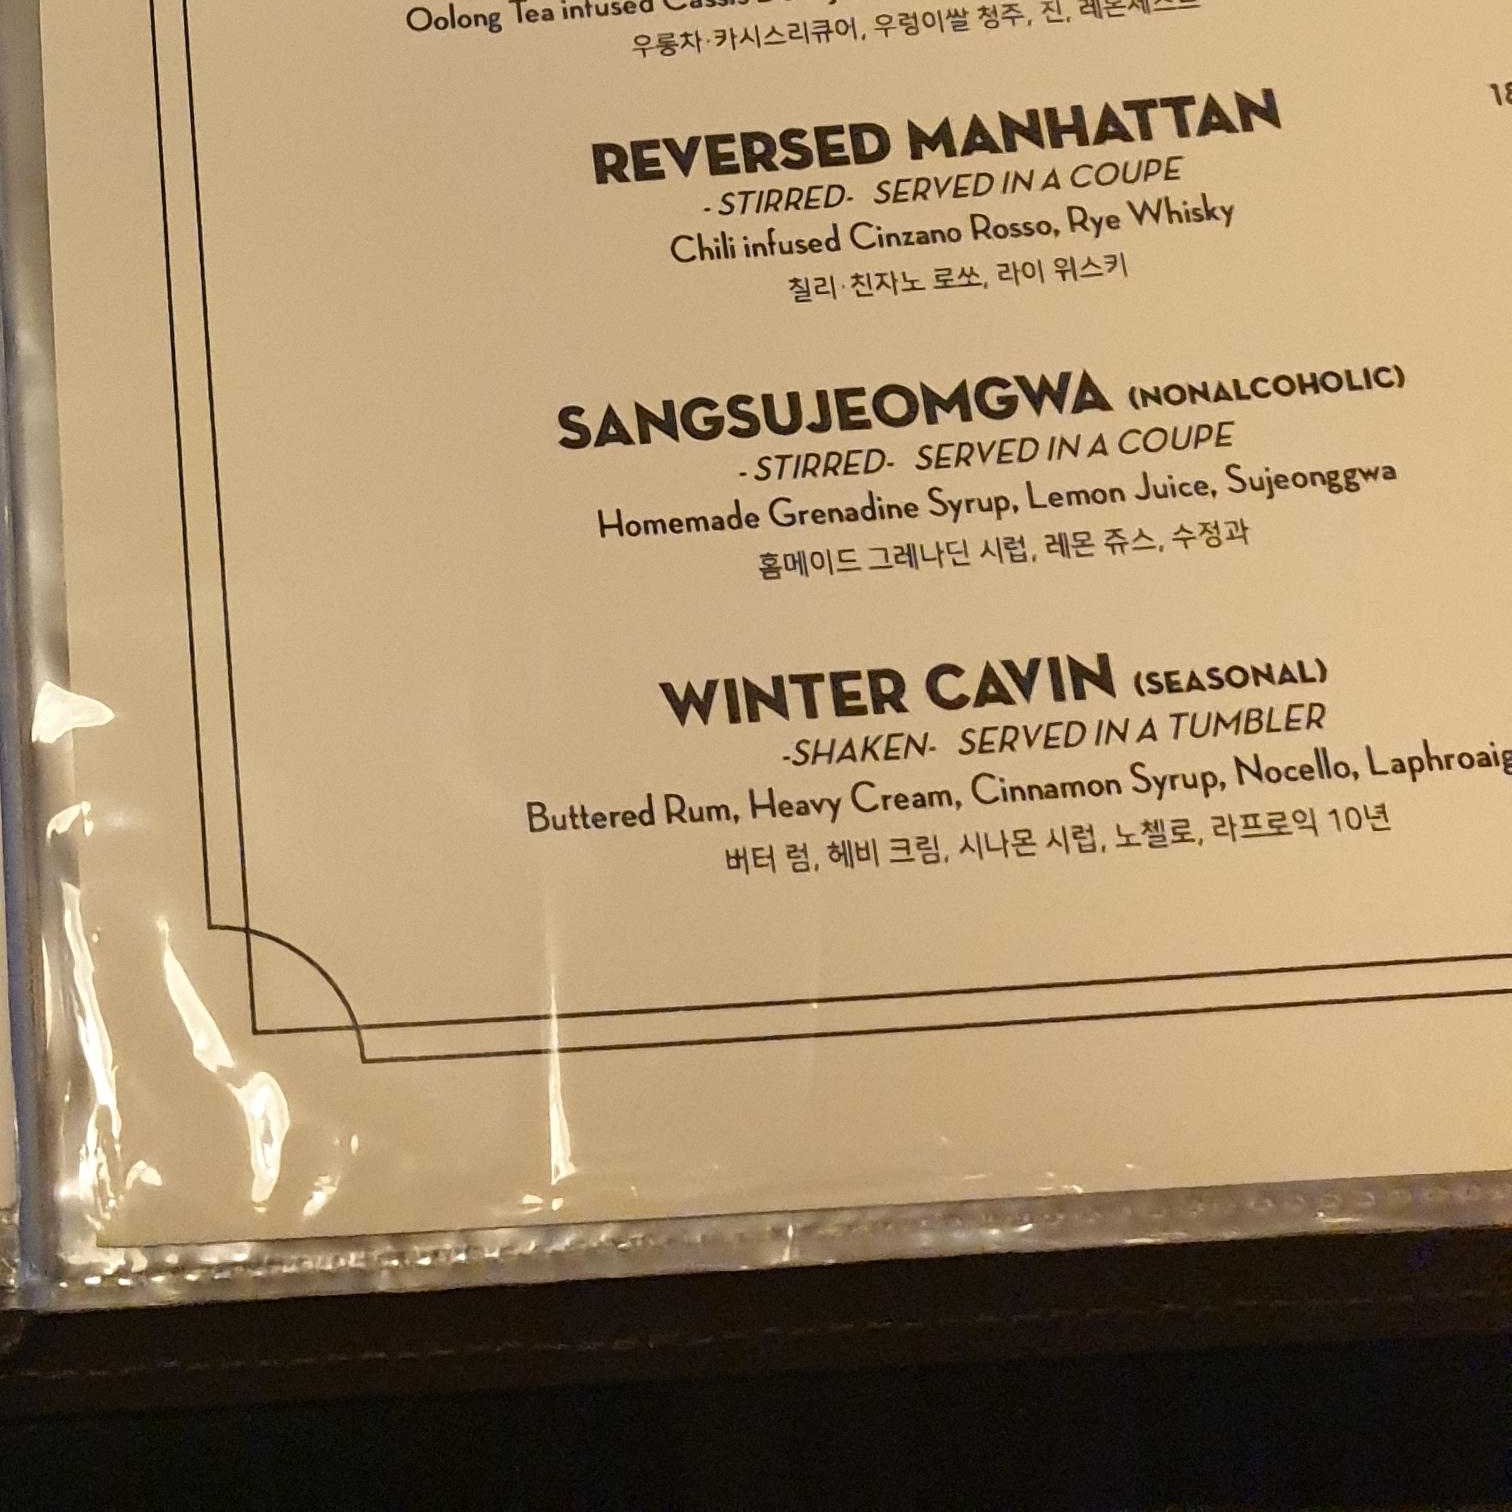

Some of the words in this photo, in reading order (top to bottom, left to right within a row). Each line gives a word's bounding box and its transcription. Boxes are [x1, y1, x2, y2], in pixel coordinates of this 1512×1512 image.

[406, 3, 502, 34] Oolong
[591, 122, 891, 185] REVERSED
[907, 88, 1282, 161] MANHATTAN
[670, 231, 736, 263] Chili
[743, 223, 841, 258] infused
[849, 221, 962, 250] Cinzano
[969, 213, 1060, 240] Rosso,
[1066, 205, 1121, 239] Rye
[1126, 193, 1234, 228] Whisky
[558, 369, 1114, 450] SANGSUJEOMGWA
[1128, 364, 1405, 410] (NONALCOHOLIC)
[597, 499, 760, 538] Homemade
[768, 490, 919, 527] Grenadine
[927, 486, 1019, 523] Syrup,
[1025, 480, 1126, 509] Lemon
[1135, 471, 1217, 501] Juice,
[1225, 463, 1397, 500] Sujeonggwa
[658, 668, 909, 727] WINTER
[925, 652, 1116, 711] CAVIN
[1134, 658, 1328, 697] (SEASONAL)
[526, 793, 655, 833] Buttered
[664, 793, 740, 824] Rum,
[748, 787, 842, 823] Heavy
[850, 780, 962, 813] Cream,
[971, 772, 1122, 805] Cinnamon
[1129, 761, 1226, 801] Syrup,
[1234, 747, 1359, 786] Nocello,
[725, 845, 776, 875] 버터
[827, 838, 879, 869] 헤비
[959, 828, 1037, 860] 시나몬
[1211, 808, 1318, 842] 라프로익
[1328, 803, 1391, 832] 10년
